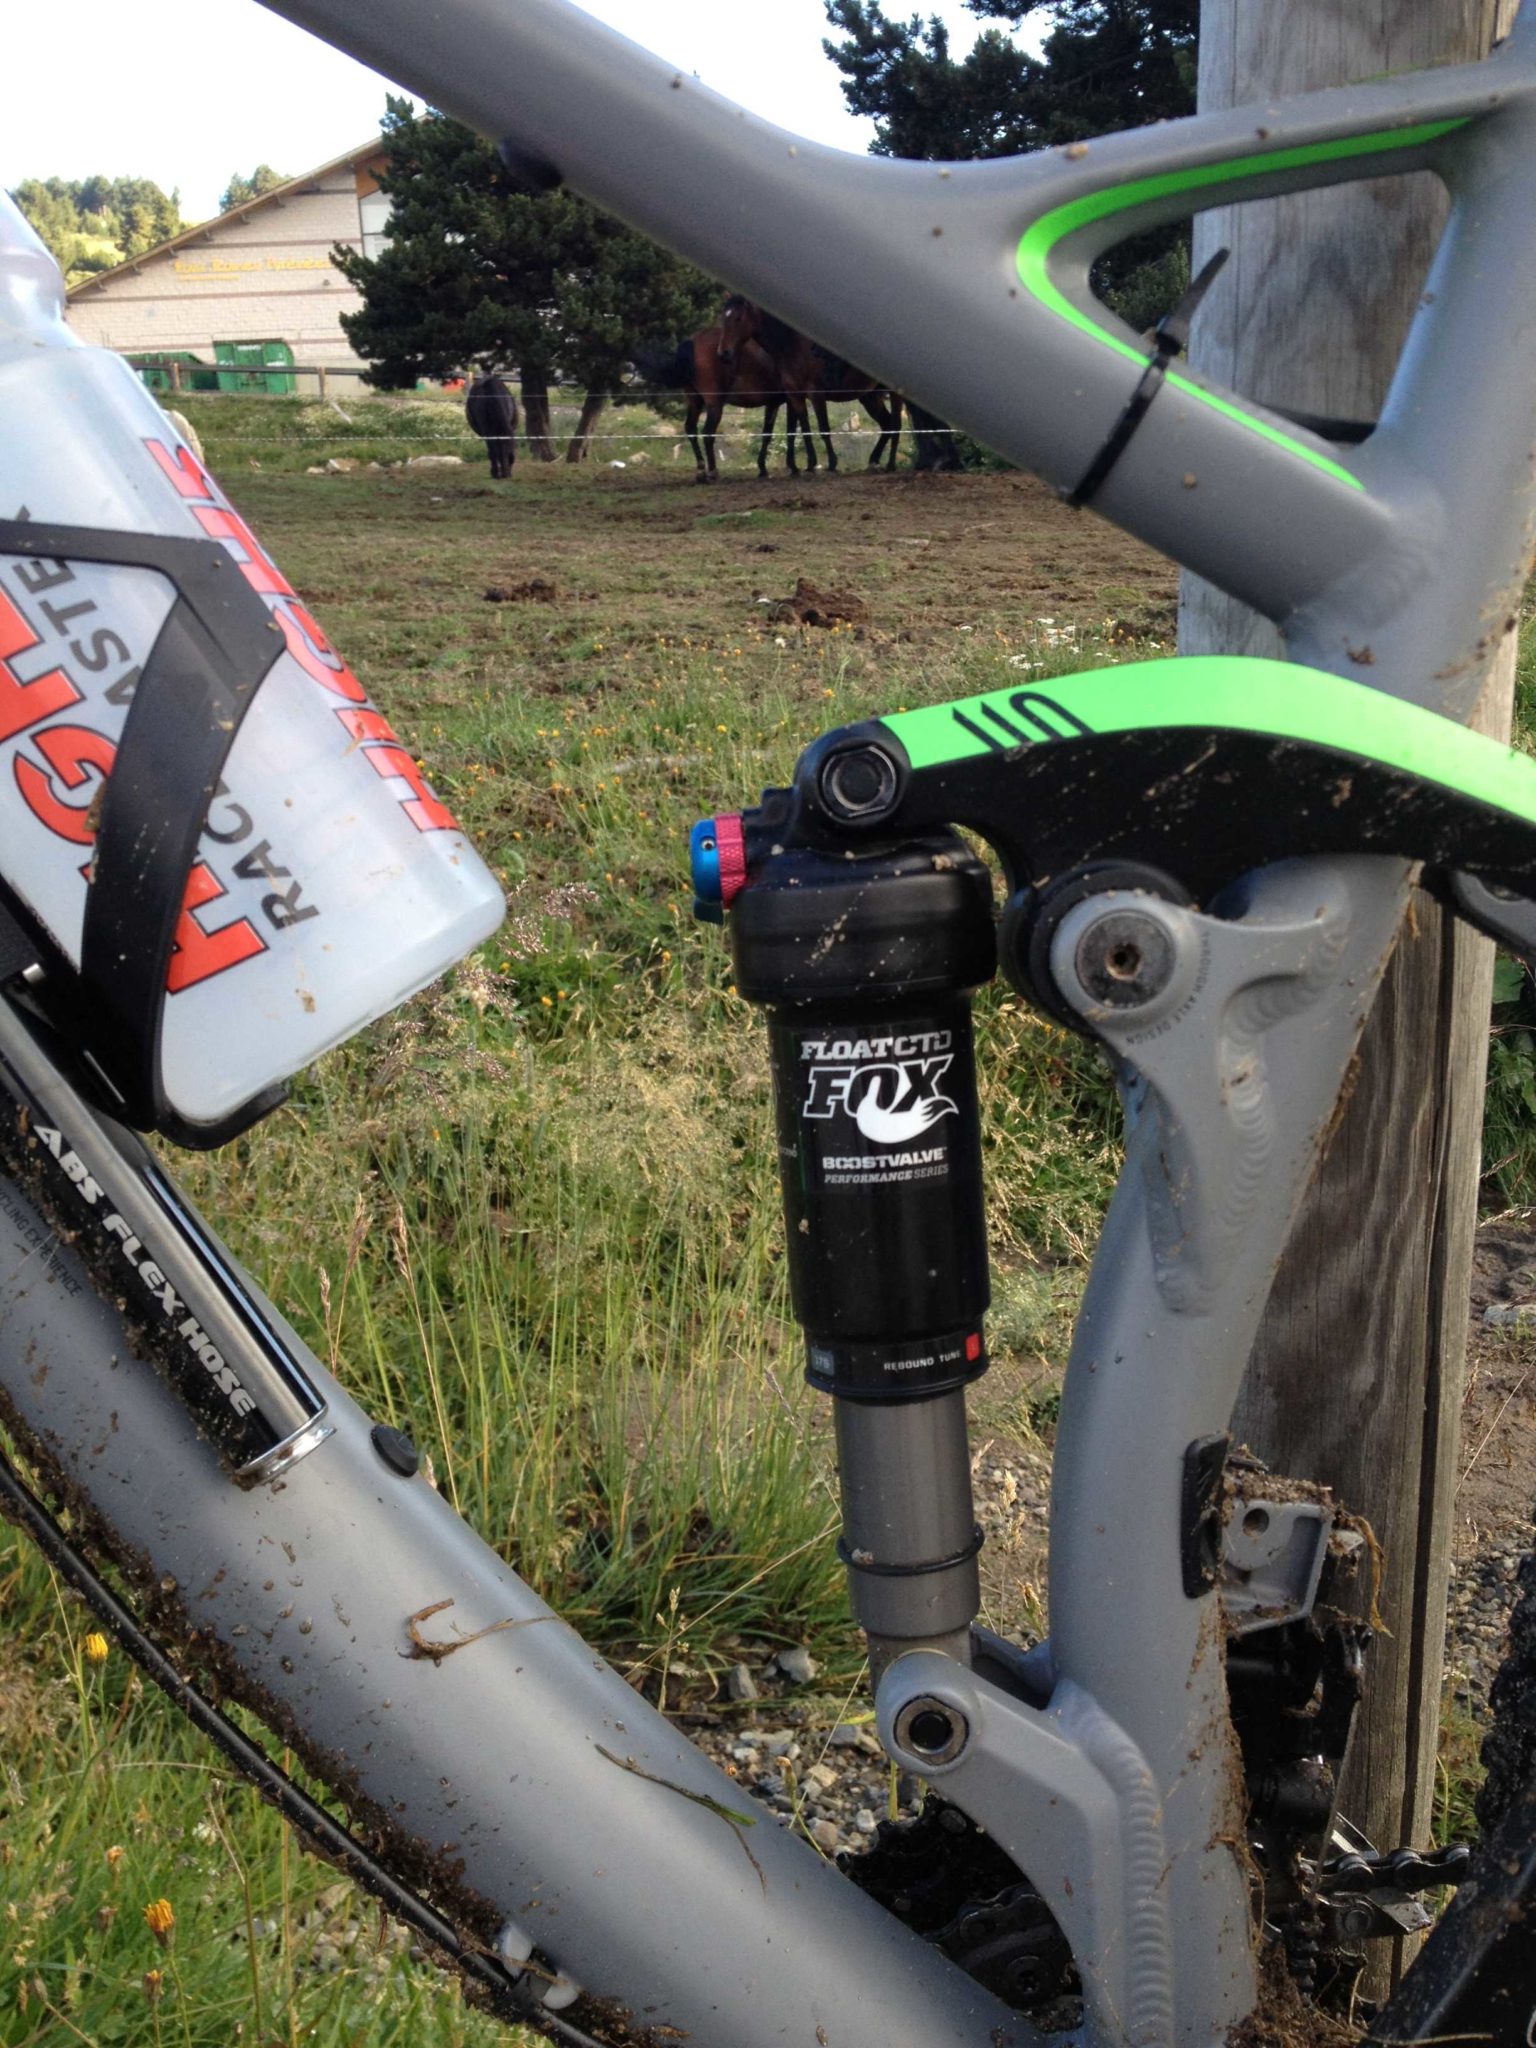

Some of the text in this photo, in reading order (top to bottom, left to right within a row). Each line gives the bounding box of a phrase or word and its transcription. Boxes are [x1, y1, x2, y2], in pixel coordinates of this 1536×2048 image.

[12, 505, 320, 930] RAC ASTE
[802, 1053, 957, 1124] FOX
[824, 1163, 949, 1184] PERFORMANCE SERIES
[0, 1190, 30, 1231] CLING
[23, 1227, 83, 1297] EXPERIENCE
[33, 1125, 104, 1204] ABS
[103, 1214, 185, 1316] FLEX
[178, 1317, 257, 1417] HOSE
[883, 1357, 935, 1372] REBOUND
[939, 1350, 962, 1363] TUNE
